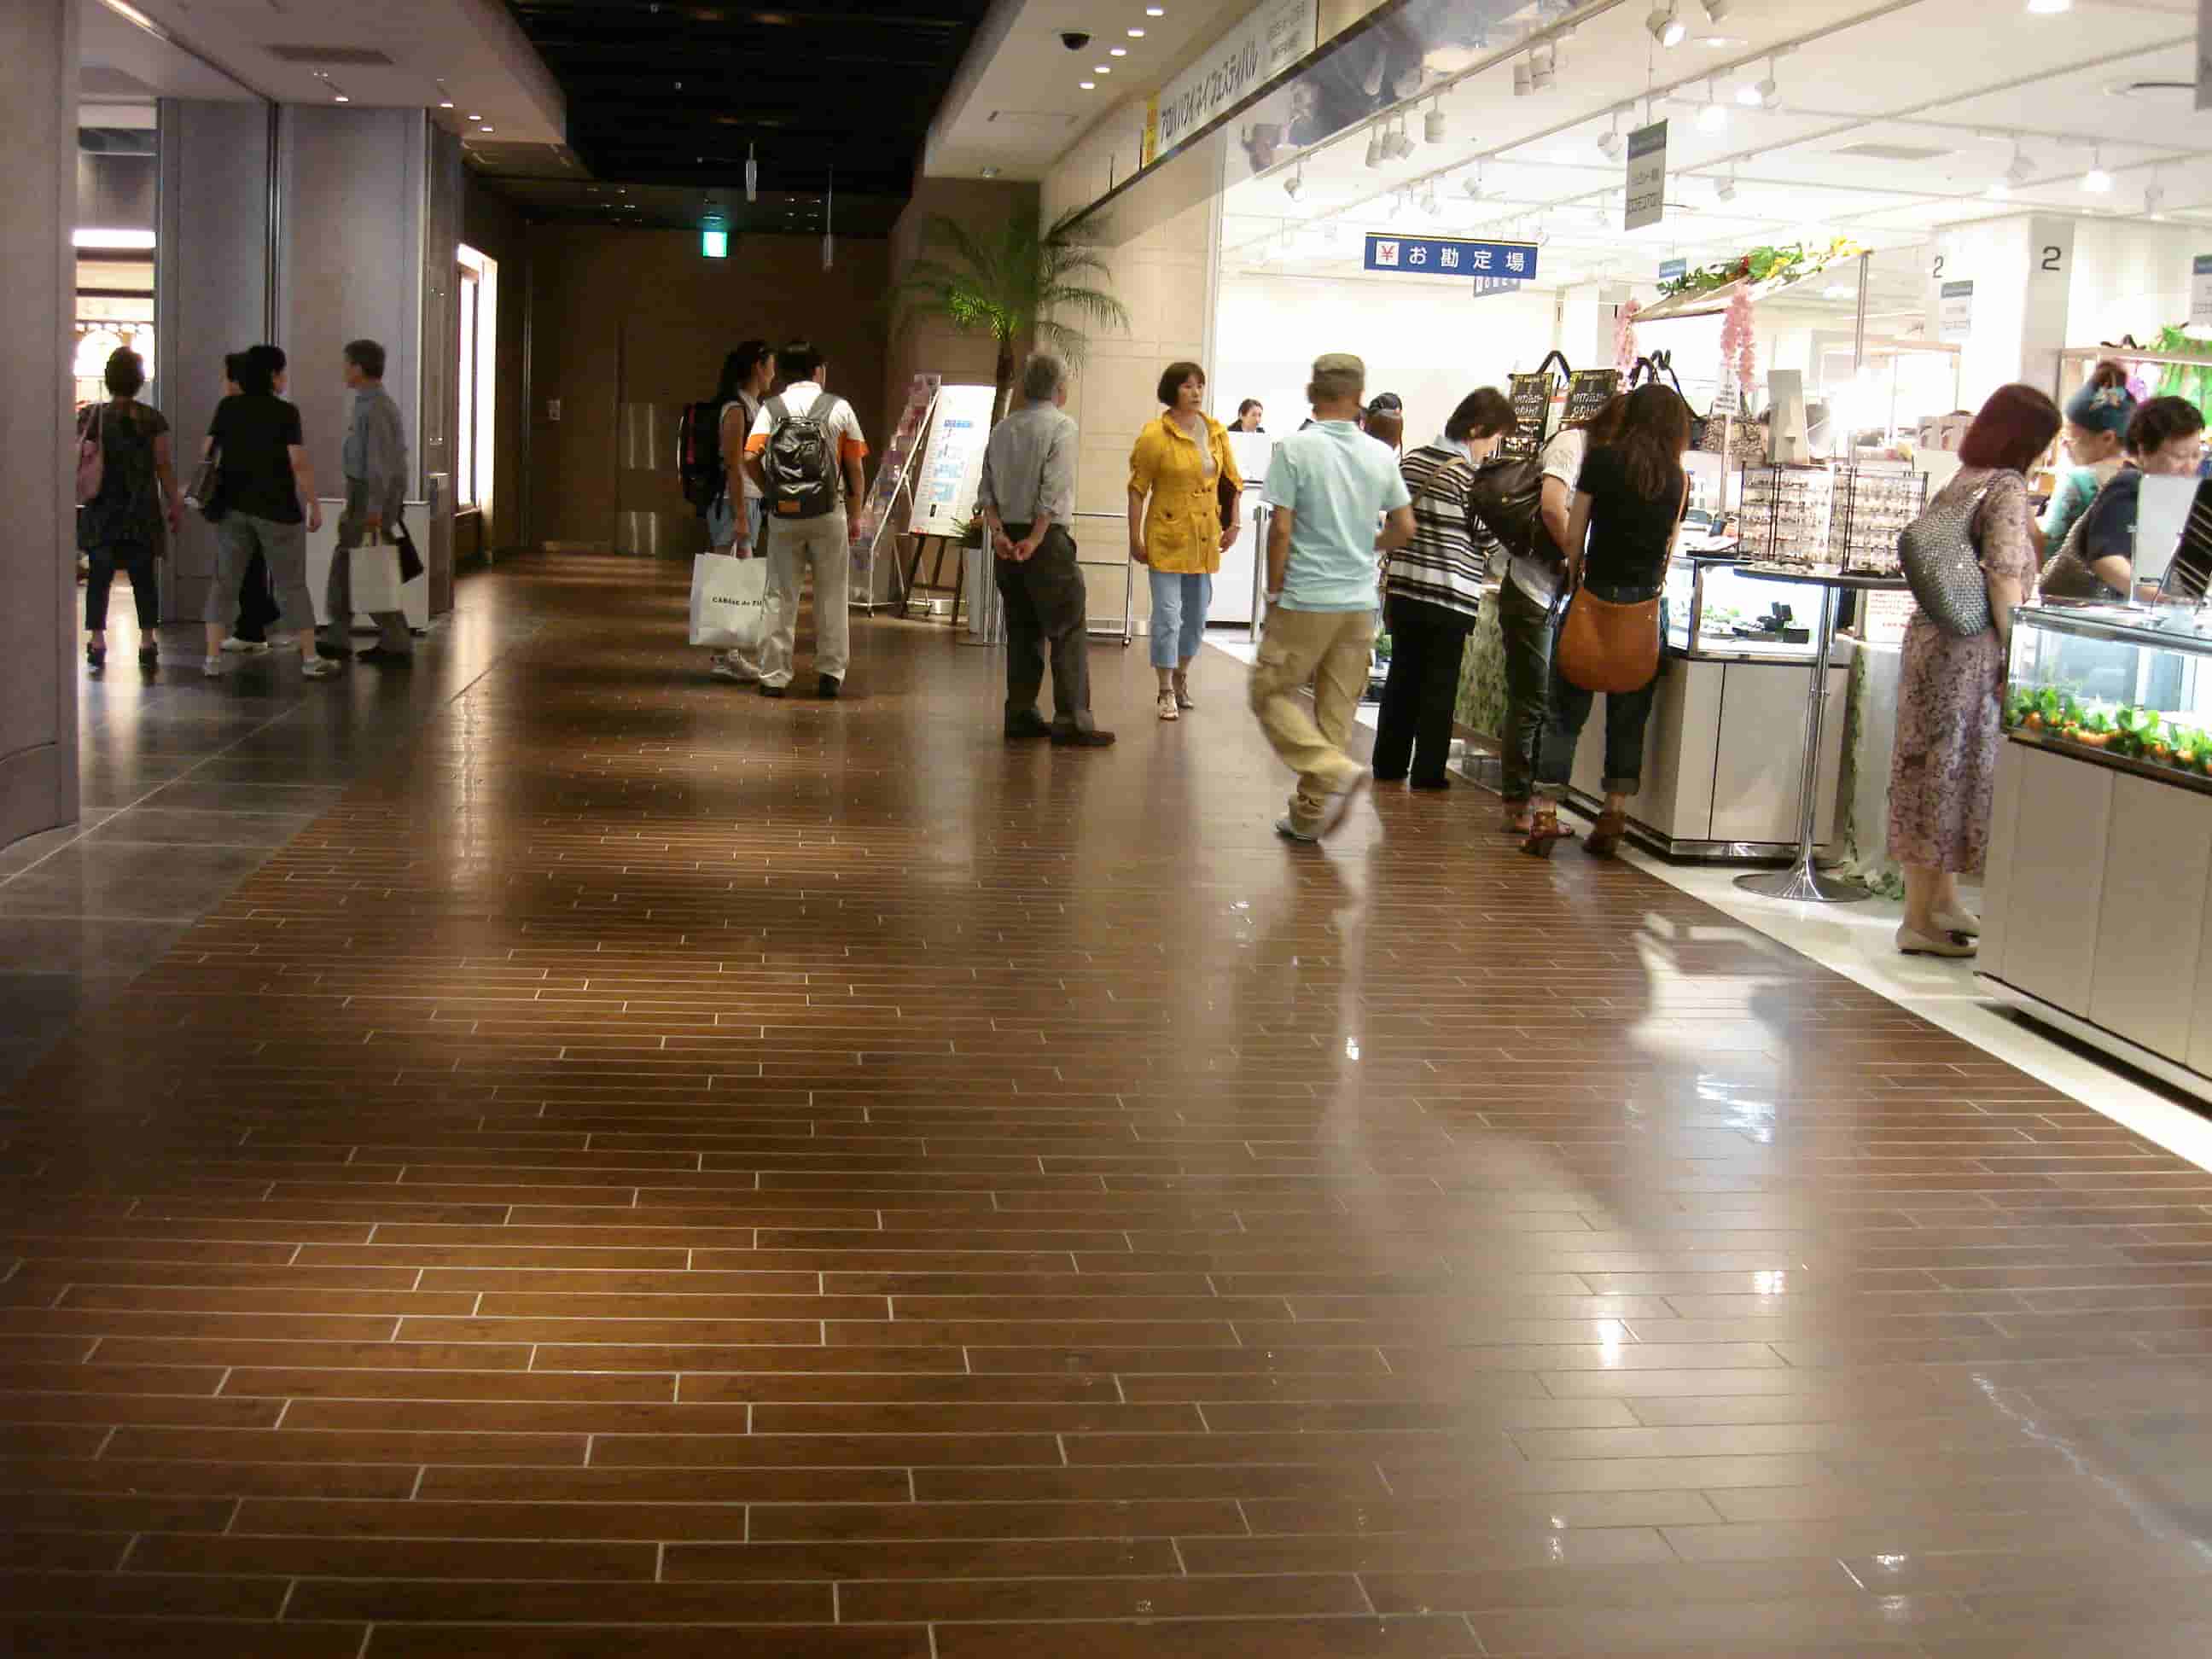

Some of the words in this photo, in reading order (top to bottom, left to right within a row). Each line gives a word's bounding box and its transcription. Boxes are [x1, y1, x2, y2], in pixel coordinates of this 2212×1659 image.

[1408, 246, 1525, 272] お勘定場
[1932, 254, 1944, 278] 2
[2040, 245, 2062, 271] 2
